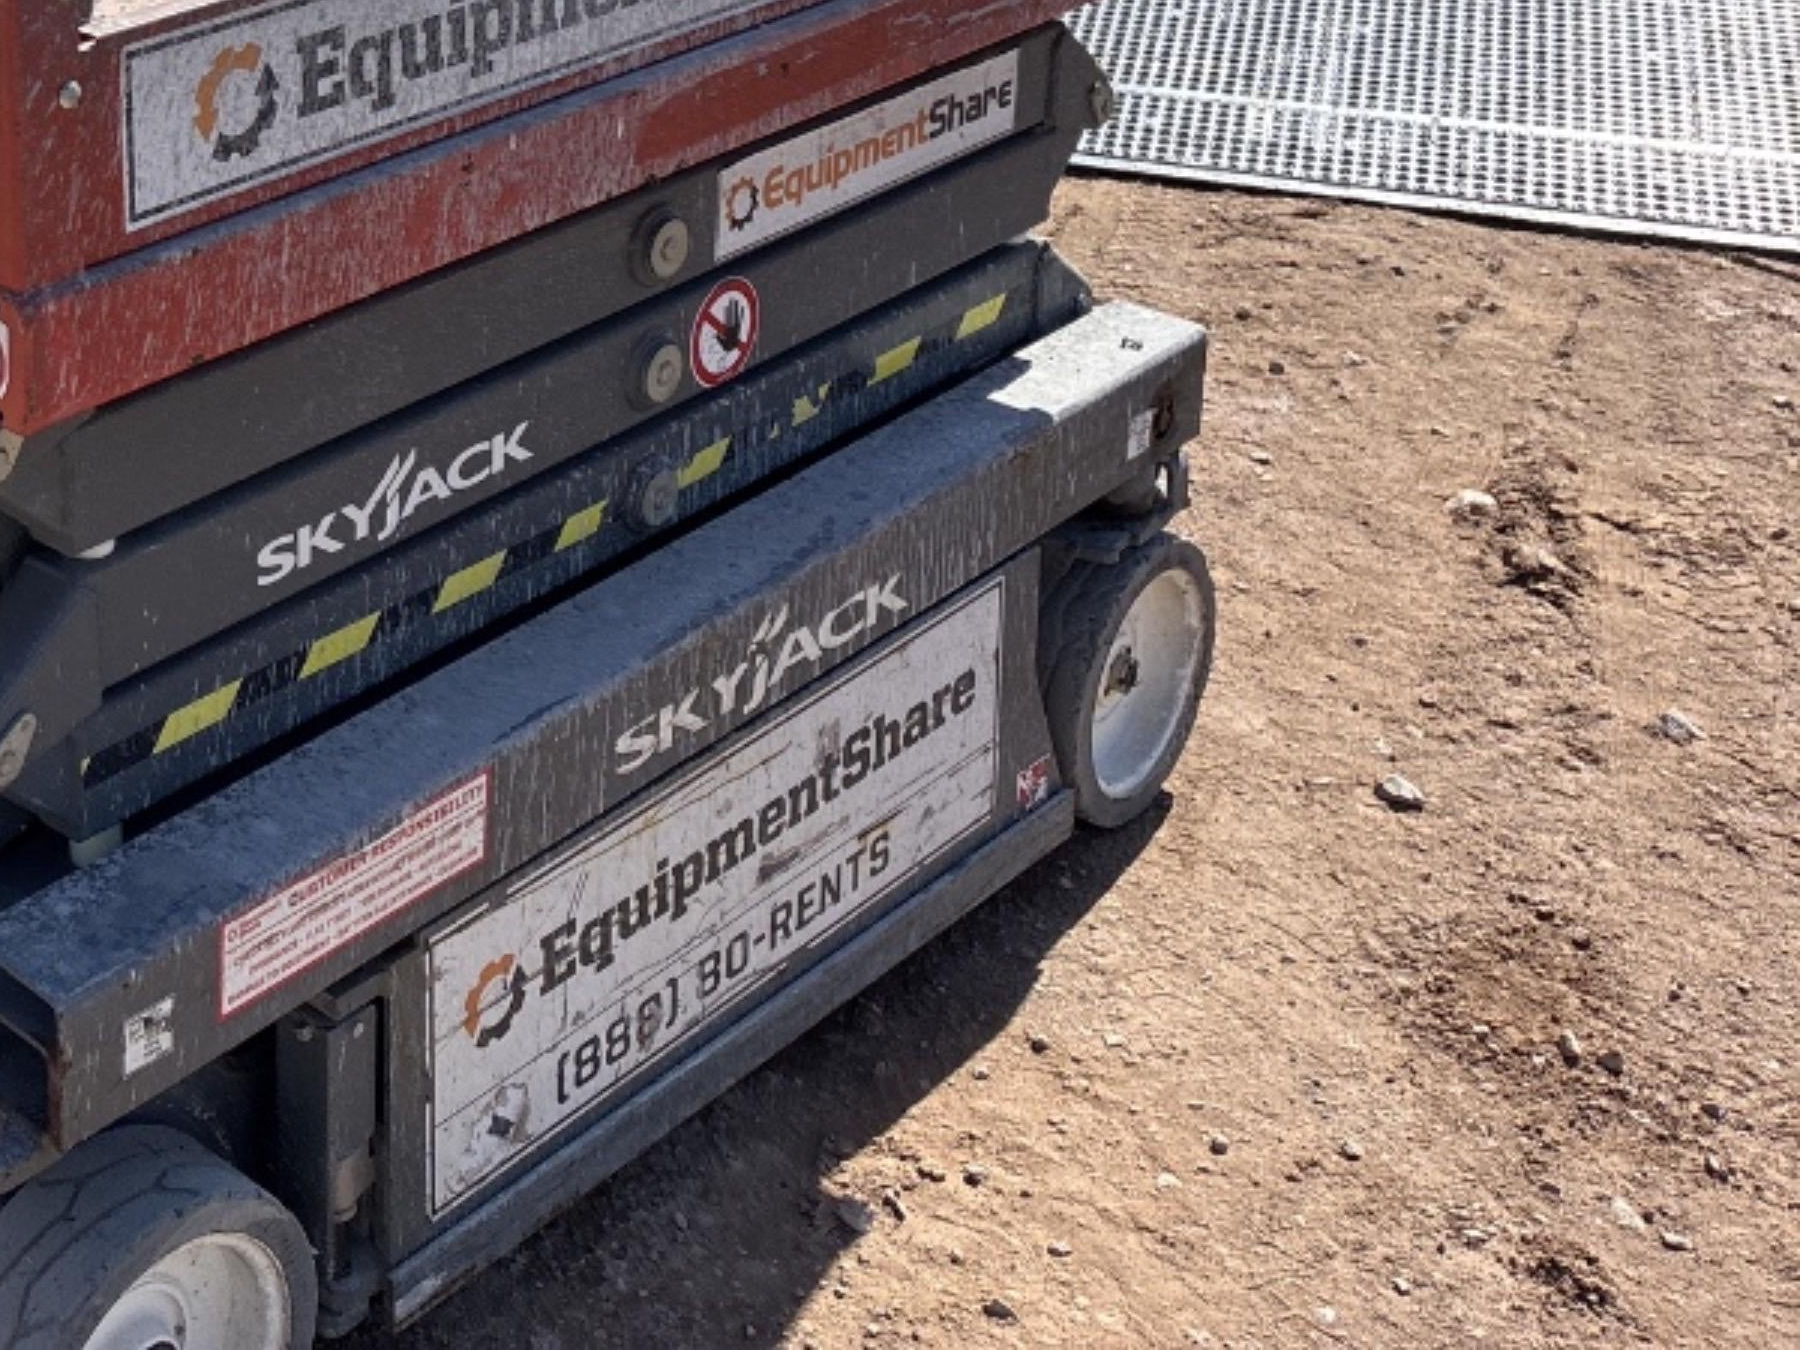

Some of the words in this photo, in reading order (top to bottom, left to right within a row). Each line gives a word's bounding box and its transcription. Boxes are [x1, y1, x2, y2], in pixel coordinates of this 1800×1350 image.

[764, 80, 1011, 209] EquipmentShare
[257, 419, 534, 586] SKYJACK
[615, 572, 908, 774] SKYJACK
[537, 668, 976, 997] EquipmentShare
[557, 977, 679, 1105] (888)
